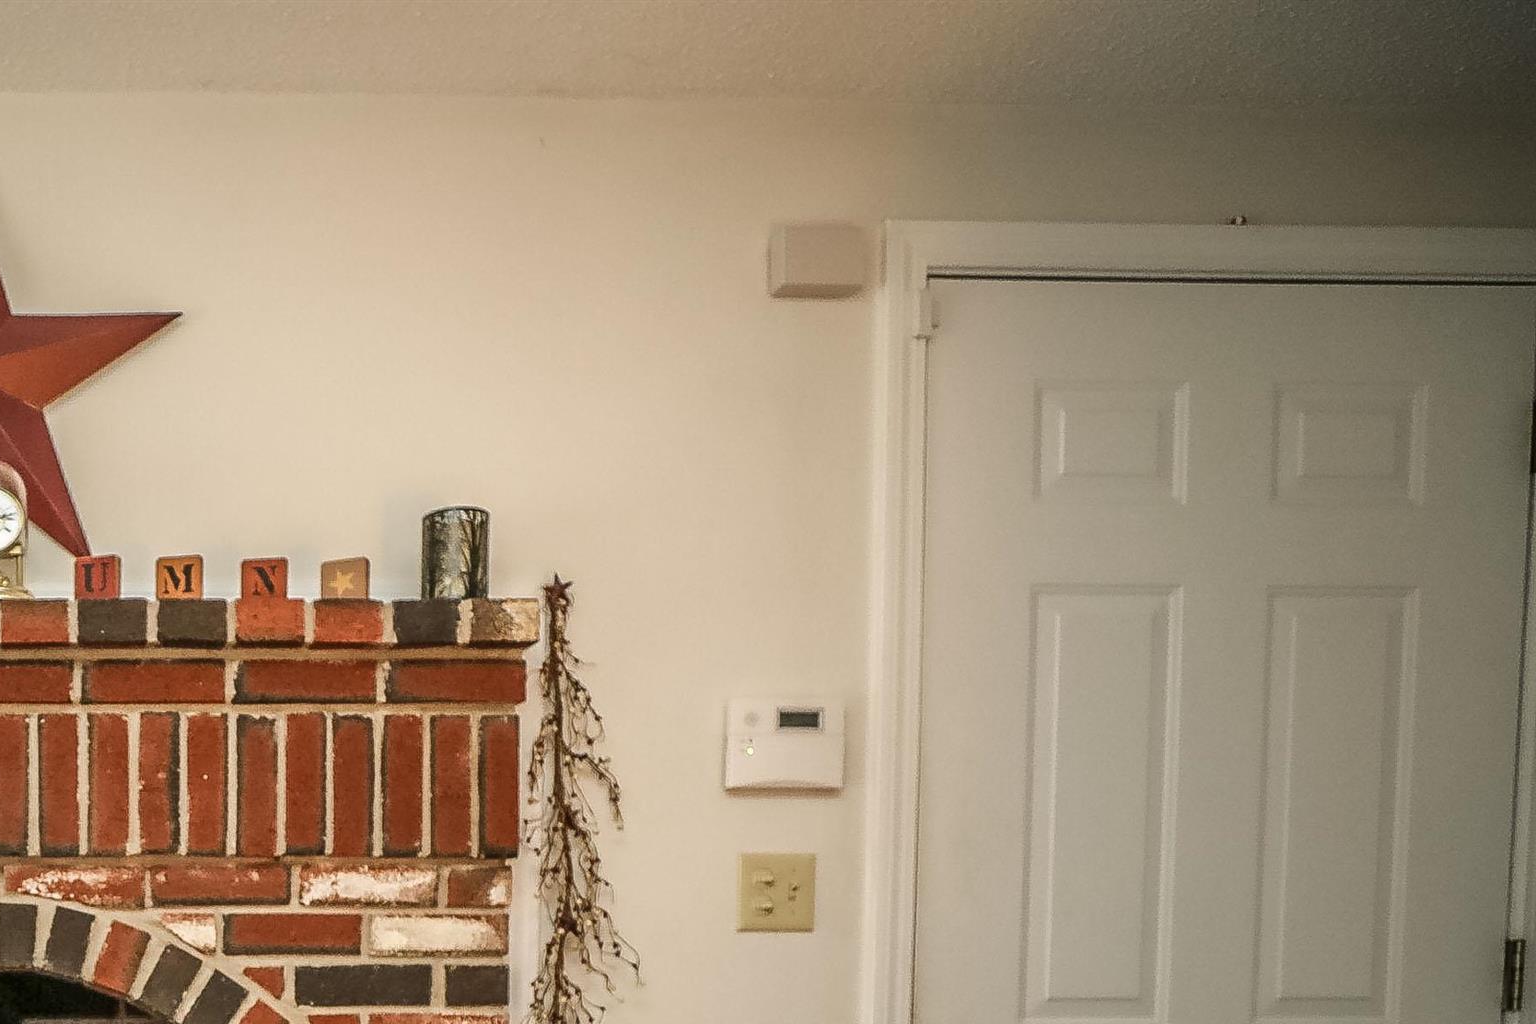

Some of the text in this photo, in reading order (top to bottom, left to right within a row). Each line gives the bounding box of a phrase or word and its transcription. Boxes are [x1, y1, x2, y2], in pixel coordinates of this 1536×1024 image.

[82, 562, 110, 592] U
[163, 563, 195, 594] M
[252, 565, 277, 596] N
